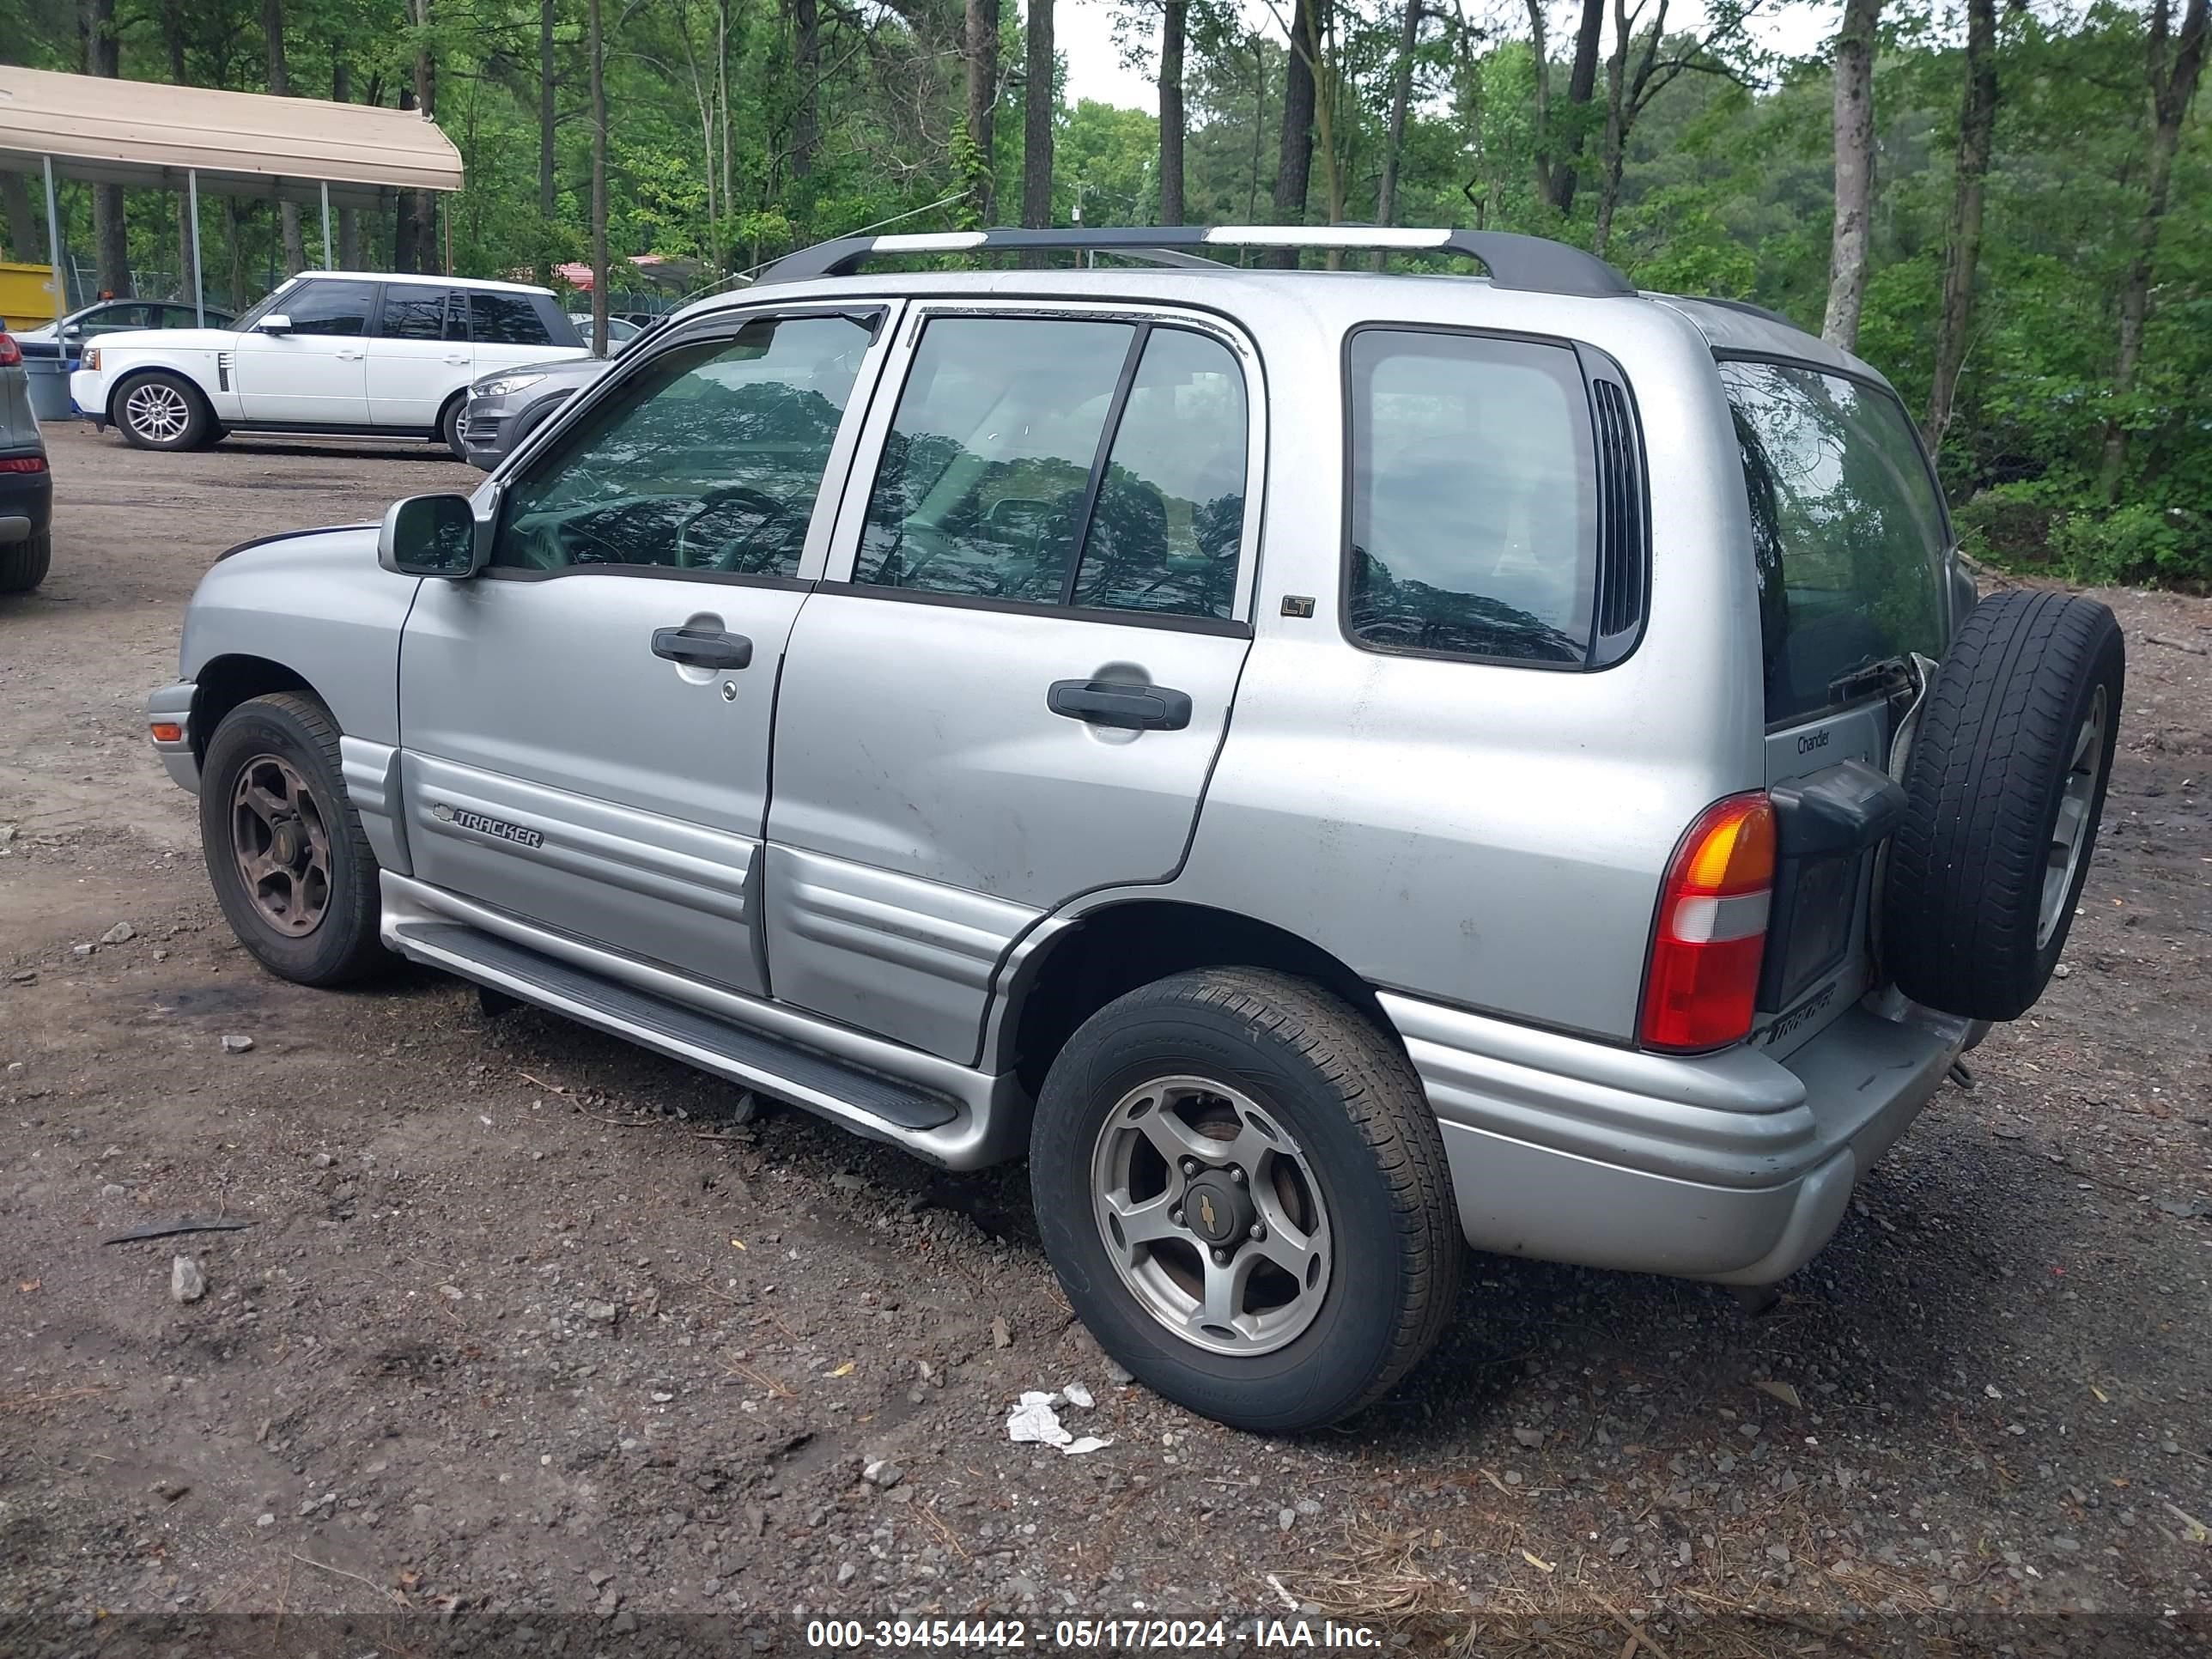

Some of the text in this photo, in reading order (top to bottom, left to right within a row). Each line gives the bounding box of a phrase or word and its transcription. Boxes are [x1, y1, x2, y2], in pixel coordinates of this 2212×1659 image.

[1283, 599, 1313, 615] LT
[1797, 728, 1830, 755] Chandler
[457, 809, 541, 848] TRACKER
